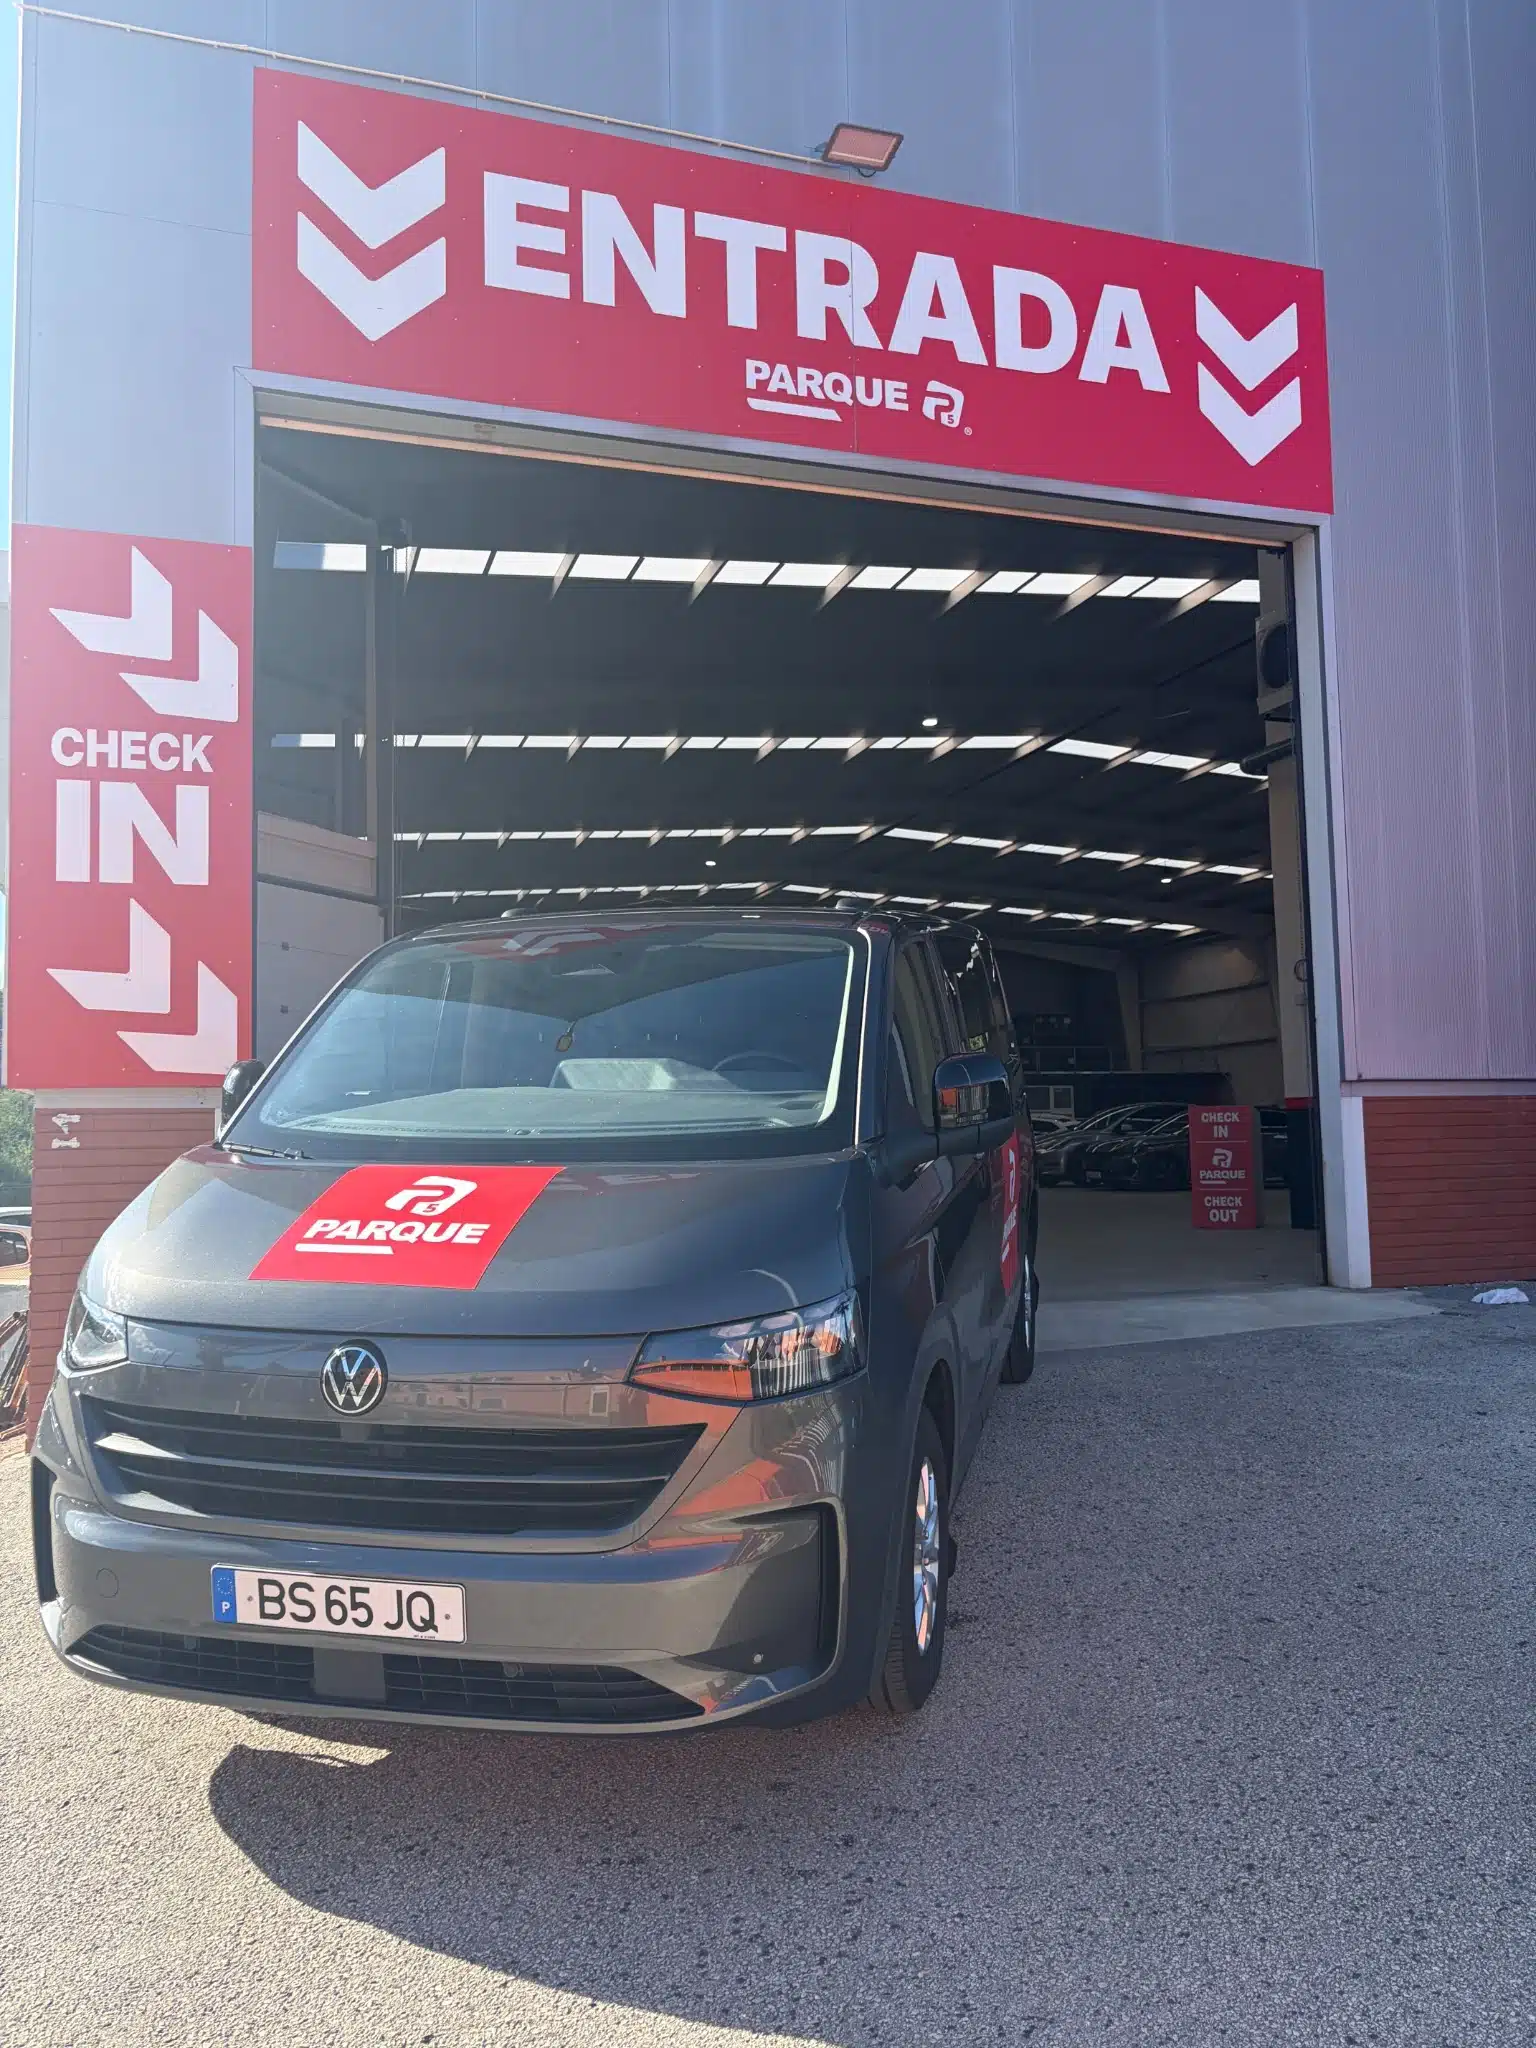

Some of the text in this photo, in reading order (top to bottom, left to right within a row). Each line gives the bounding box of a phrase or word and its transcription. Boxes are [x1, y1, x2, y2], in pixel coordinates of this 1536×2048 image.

[484, 171, 1170, 393] ENTRADA
[746, 358, 909, 412] PARQUE
[51, 728, 213, 772] CHECK
[55, 779, 210, 886] IN
[1201, 1112, 1240, 1123] CHECK
[1213, 1125, 1229, 1138] IN
[1200, 1170, 1246, 1179] PARQUE
[1204, 1196, 1243, 1207] CHECK
[1209, 1209, 1238, 1222] OUT
[303, 1219, 491, 1244] PARQUE
[221, 1601, 231, 1614] P
[258, 1578, 439, 1633] BS 65 JQ
